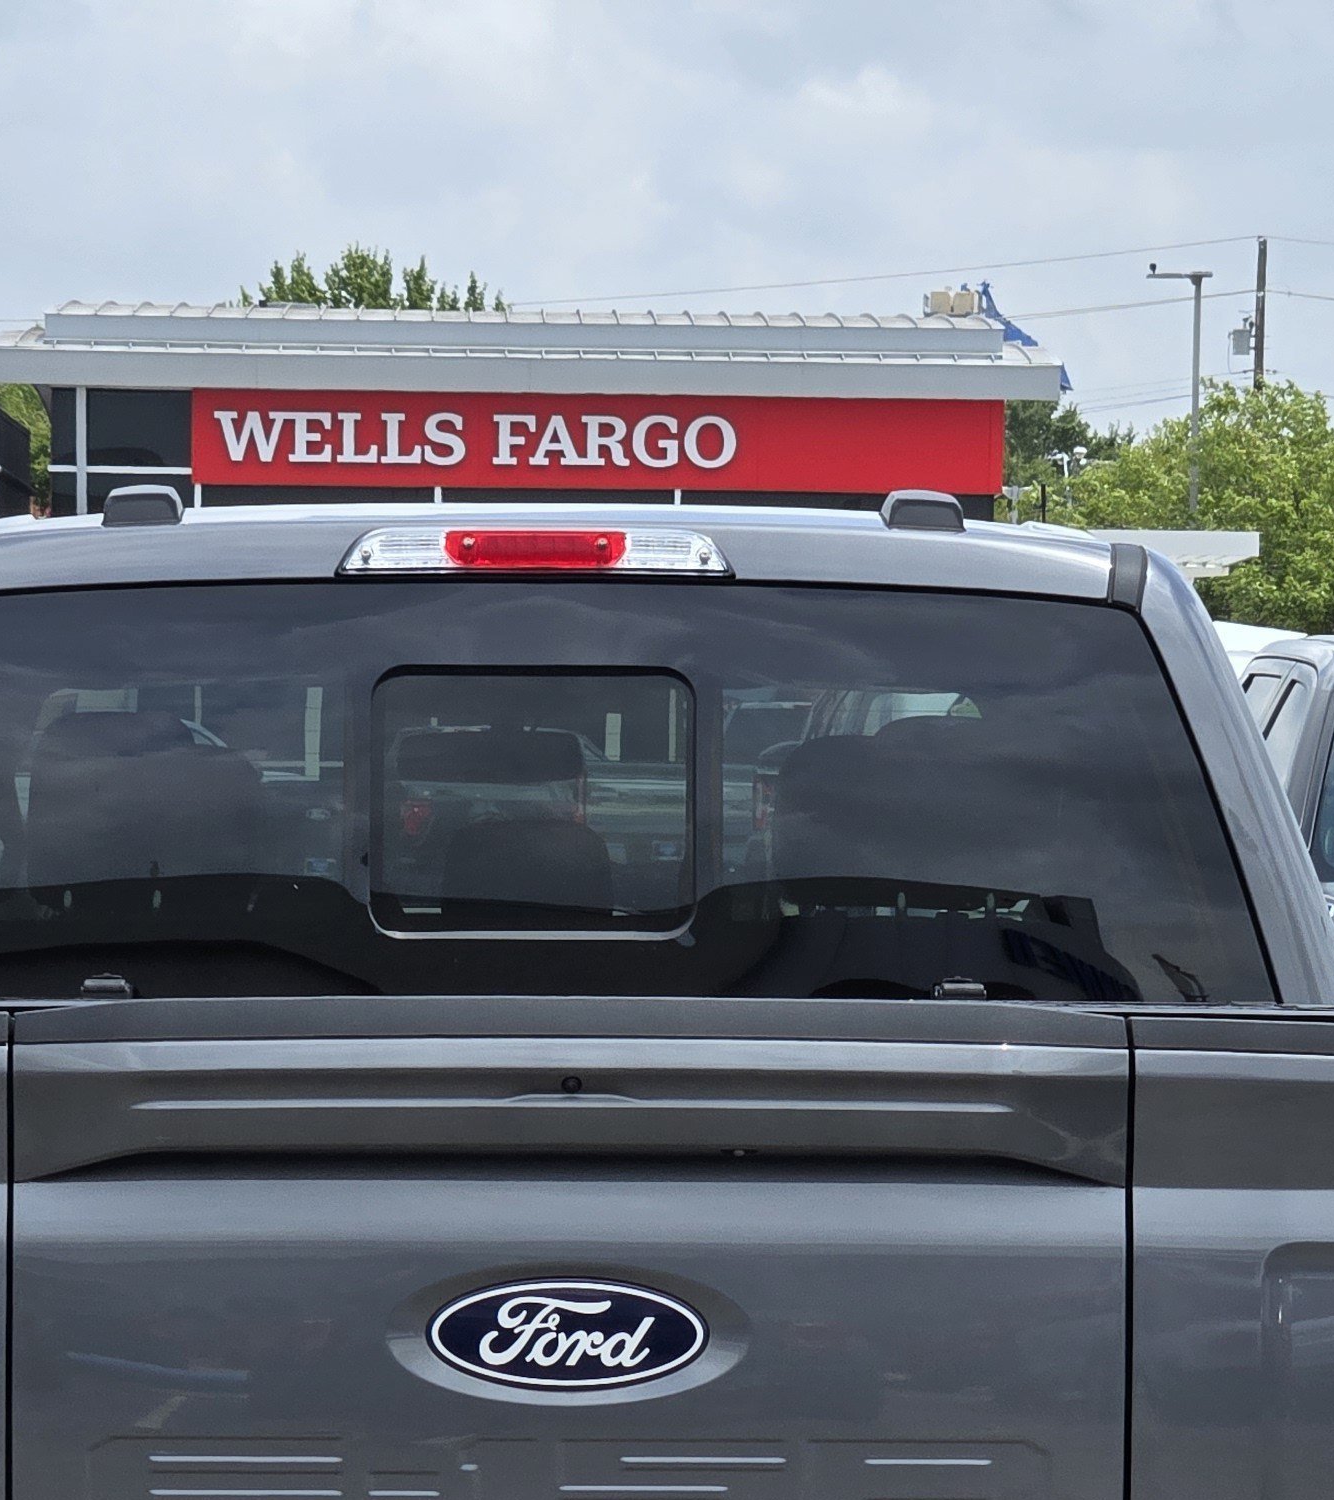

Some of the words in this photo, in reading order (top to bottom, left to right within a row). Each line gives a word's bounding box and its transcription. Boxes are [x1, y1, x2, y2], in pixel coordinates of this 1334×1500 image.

[213, 410, 466, 466] WELLS
[491, 413, 738, 469] FARGO
[479, 1296, 656, 1368] Ford
